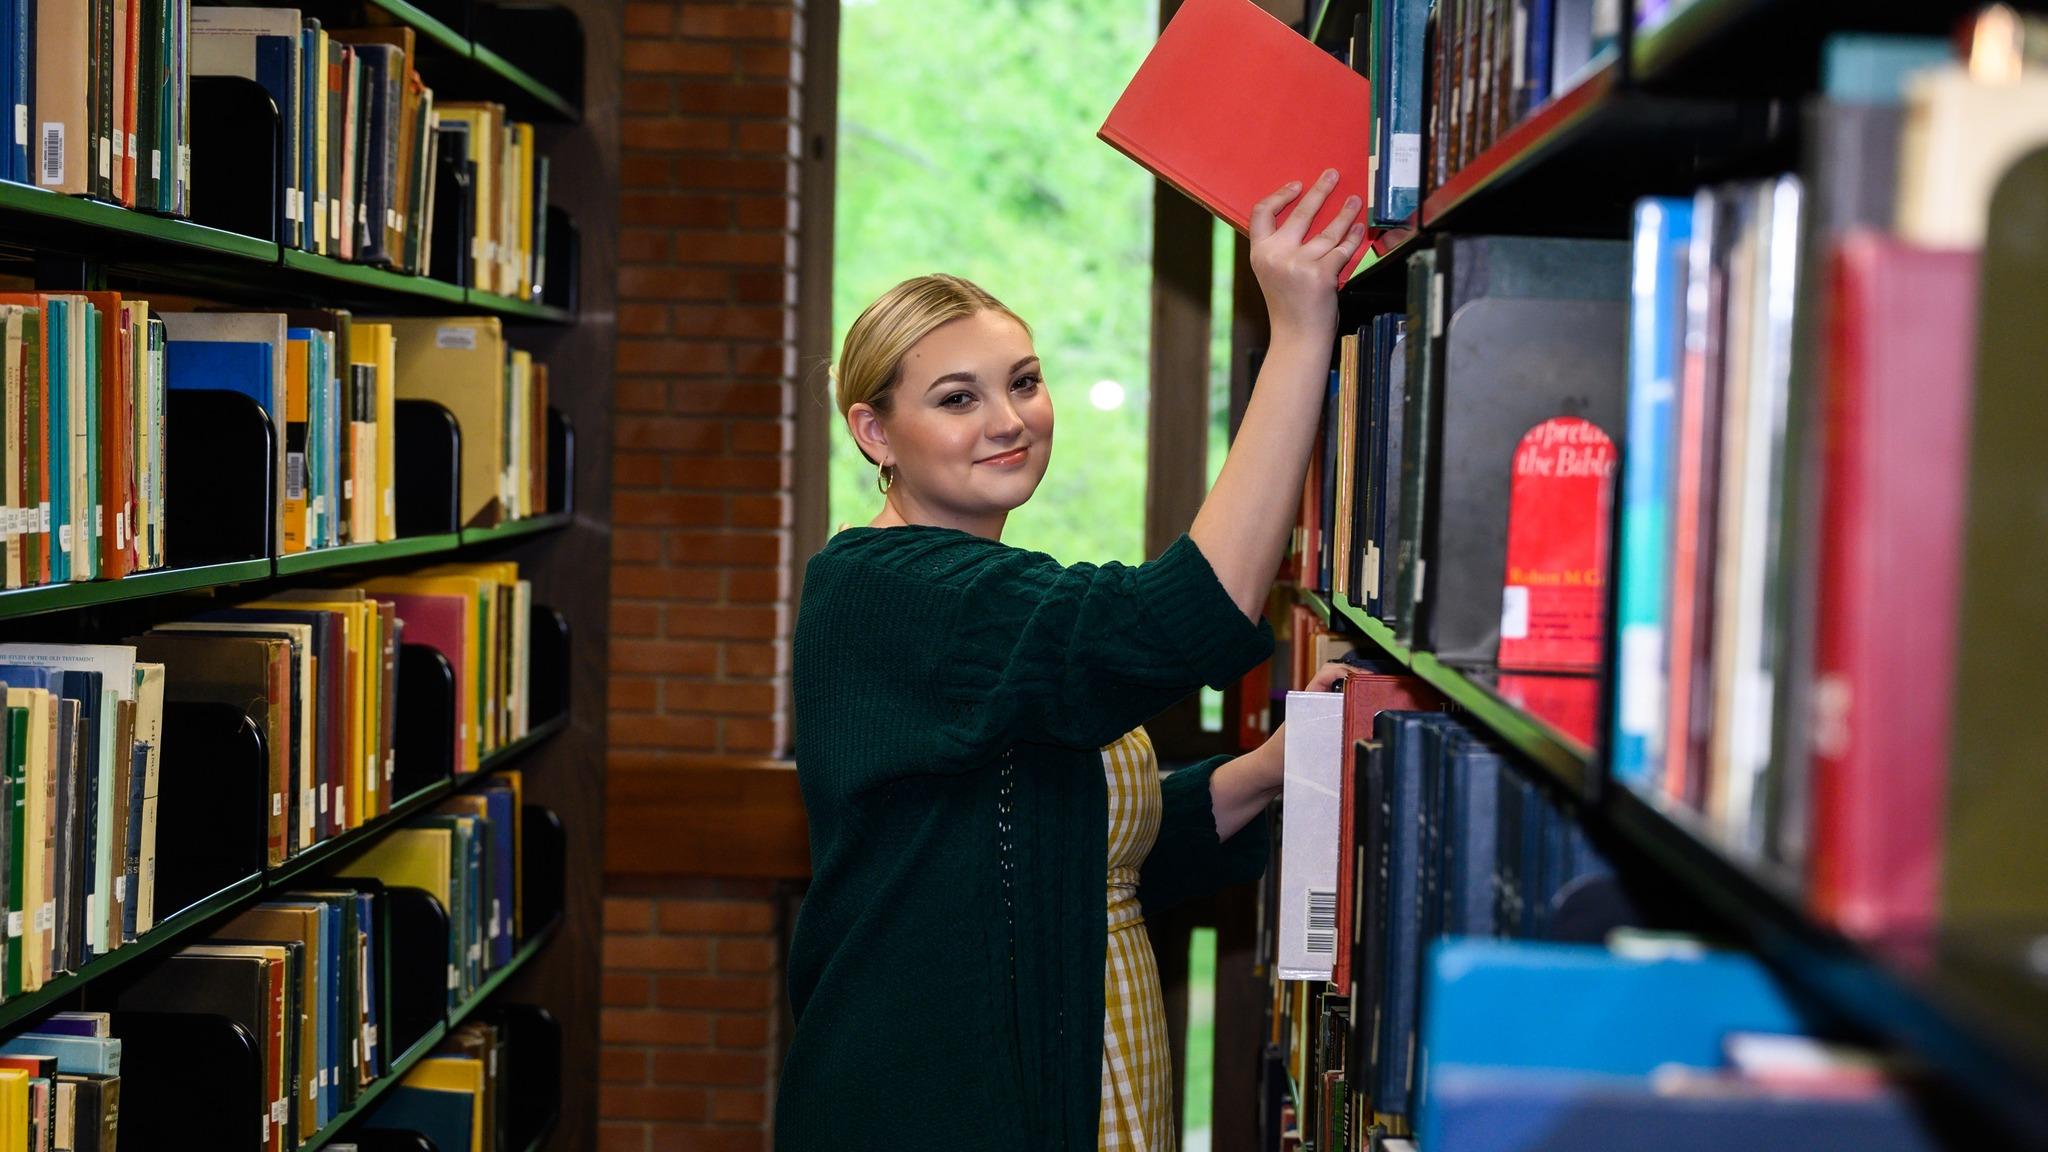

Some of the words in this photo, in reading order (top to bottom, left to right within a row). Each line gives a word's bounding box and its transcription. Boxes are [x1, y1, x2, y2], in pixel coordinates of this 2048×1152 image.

[1517, 445, 1553, 478] the
[1556, 445, 1617, 479] Bible
[62, 655, 95, 663] TESTAMENT
